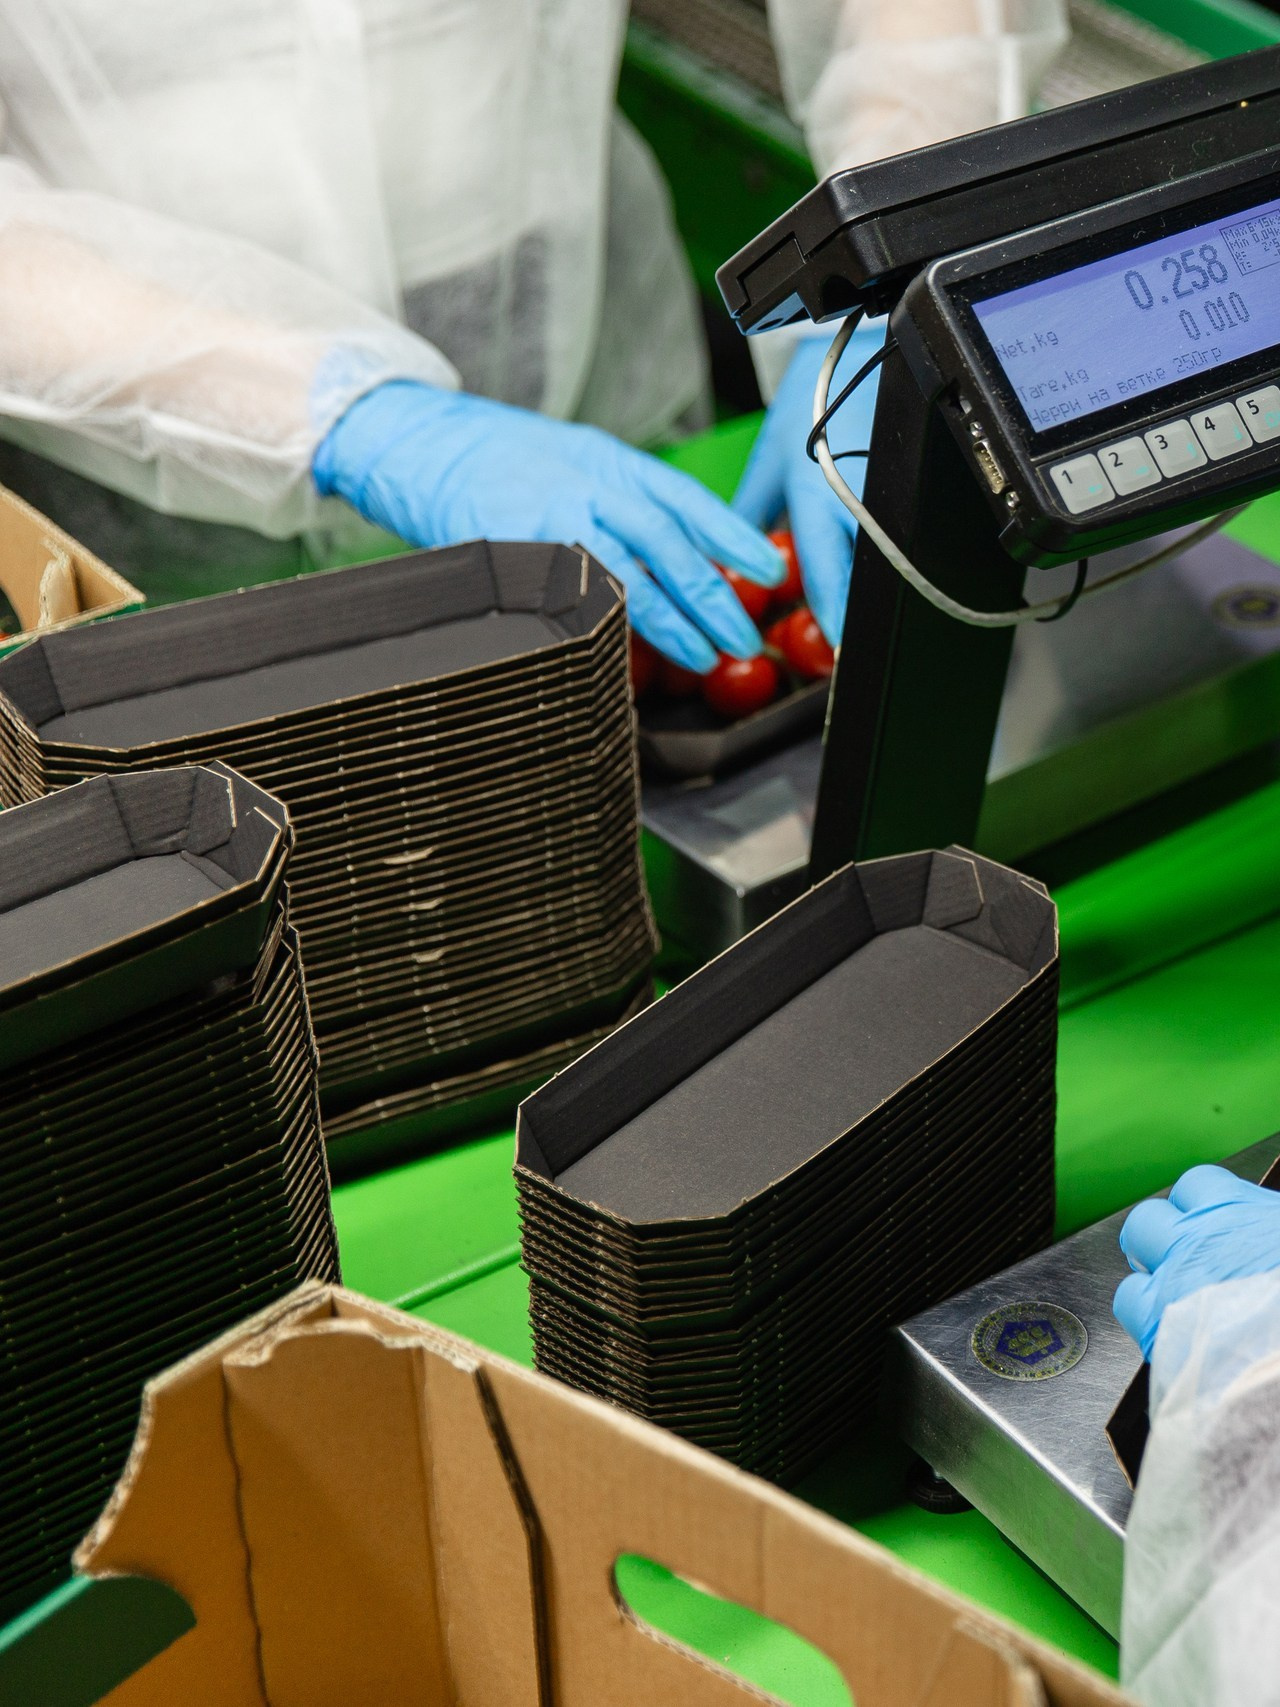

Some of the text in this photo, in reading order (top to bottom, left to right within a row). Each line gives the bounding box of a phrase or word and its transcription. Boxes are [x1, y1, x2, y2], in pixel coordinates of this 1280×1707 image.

[1124, 244, 1228, 310] 0.258
[1179, 291, 1250, 341] 0.010
[994, 331, 1060, 362] Net,kg
[1017, 368, 1090, 403] Tare,kg
[1088, 387, 1111, 407] на
[1172, 347, 1222, 374] 250гр
[1061, 469, 1073, 485] 1
[1108, 452, 1123, 468] 2
[1154, 434, 1169, 450] 3
[1204, 416, 1216, 431] 4
[1246, 399, 1260, 415] 5
